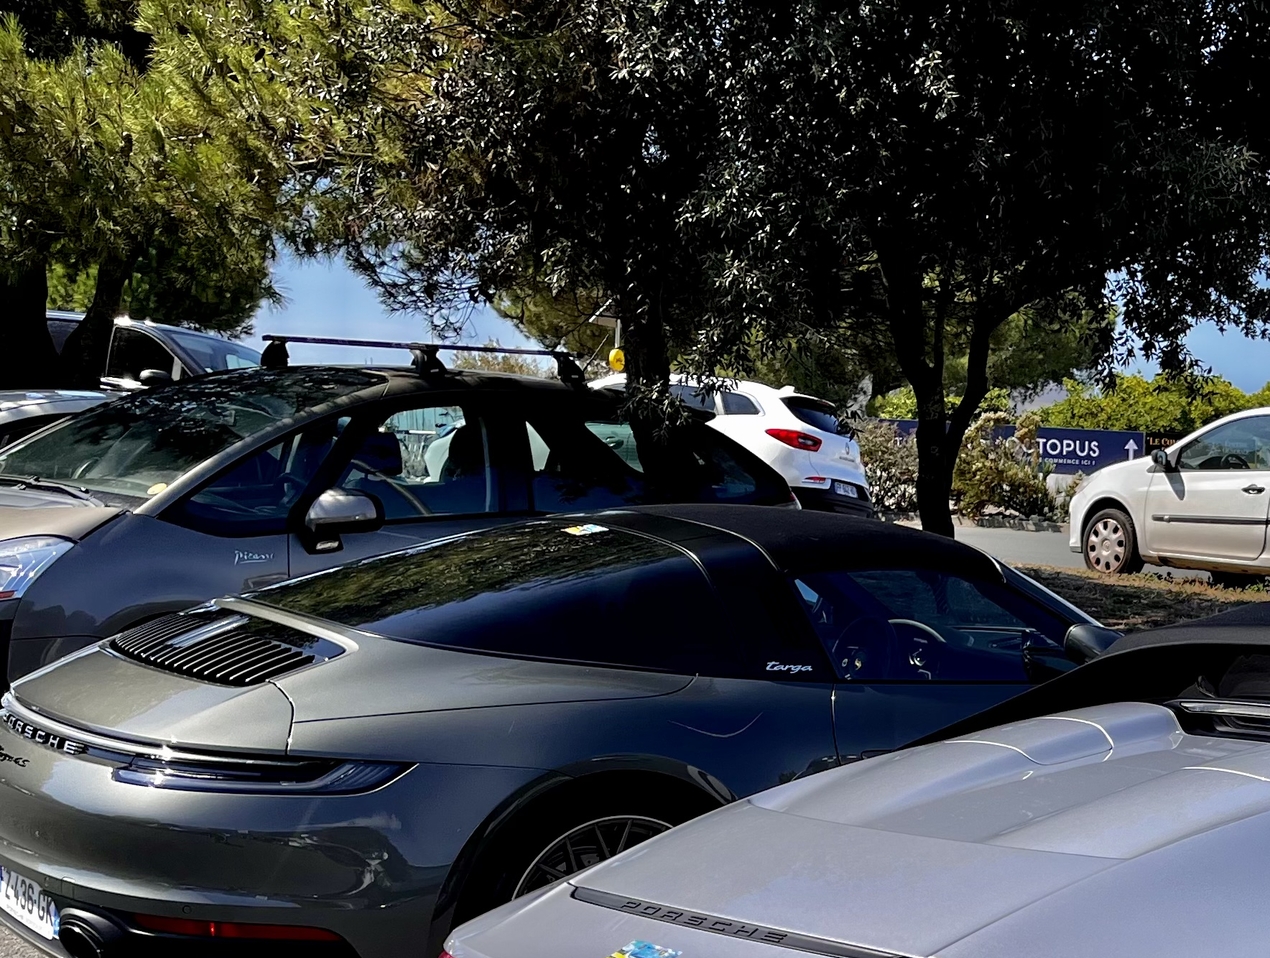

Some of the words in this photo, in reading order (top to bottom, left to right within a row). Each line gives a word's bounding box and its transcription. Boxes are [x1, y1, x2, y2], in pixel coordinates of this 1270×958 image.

[1045, 457, 1079, 465] COMMENCE
[766, 661, 813, 674] targa
[620, 900, 788, 944] PORSCHE
